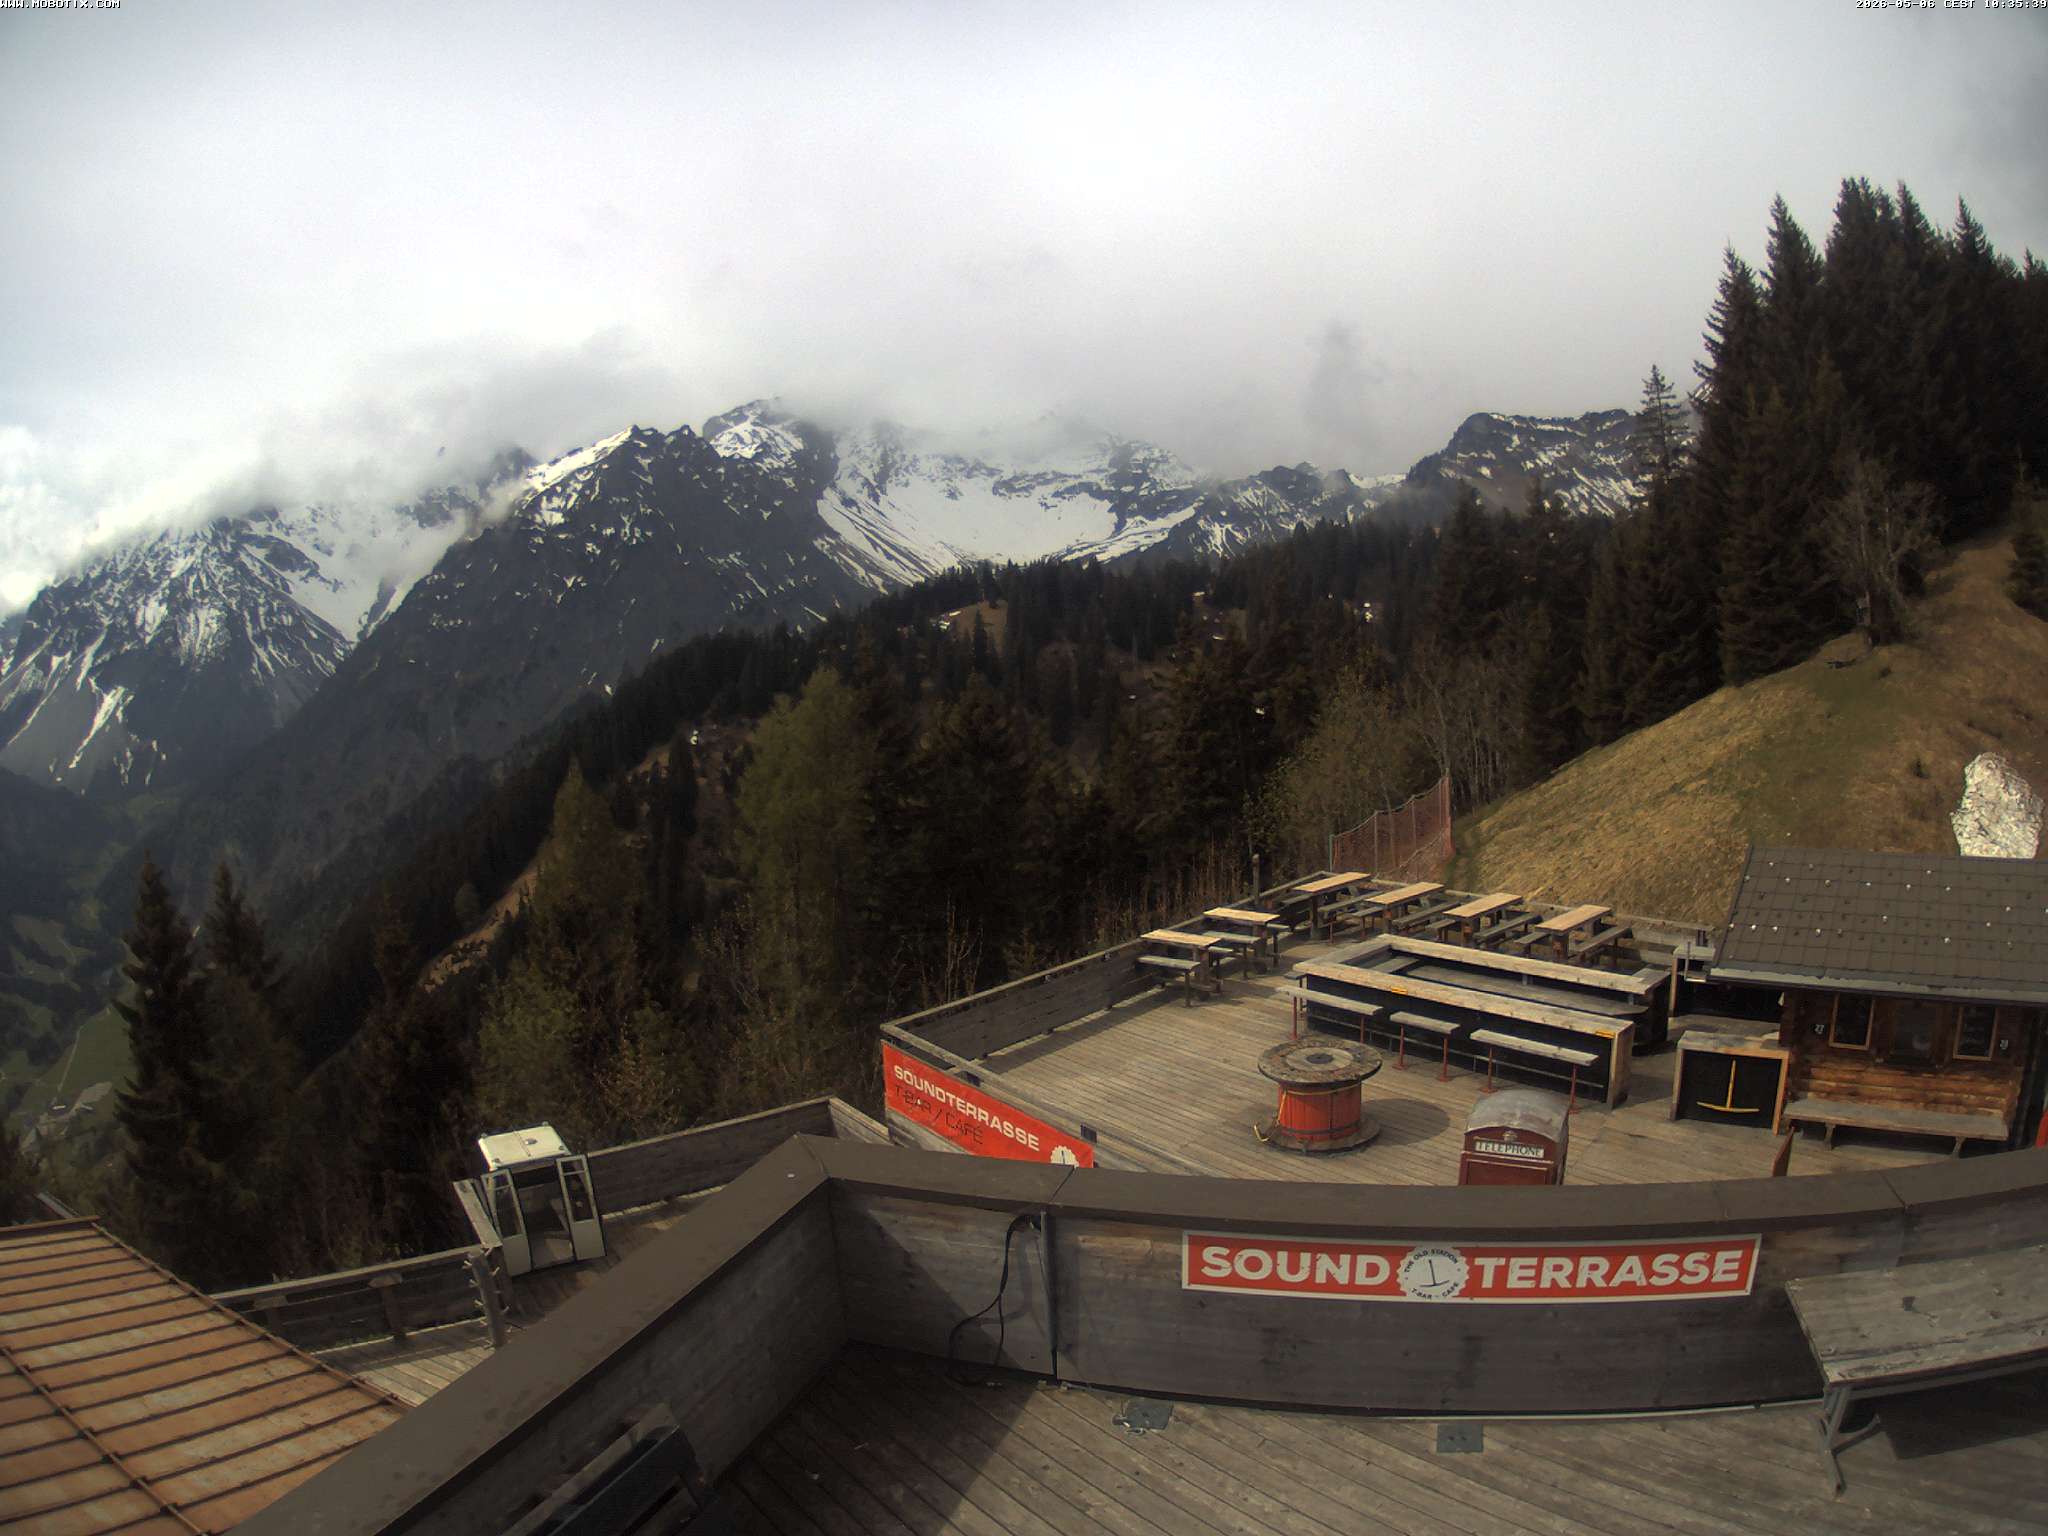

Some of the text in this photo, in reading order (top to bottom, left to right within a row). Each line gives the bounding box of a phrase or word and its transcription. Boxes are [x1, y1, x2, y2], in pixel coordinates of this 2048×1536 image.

[894, 1064, 1040, 1151] SOUNDTERRASSE
[1477, 1141, 1542, 1157] TELEPHONE
[1201, 1246, 1390, 1286] SOUND
[1413, 1250, 1428, 1260] OLD
[1474, 1250, 1742, 1288] TERRASSE
